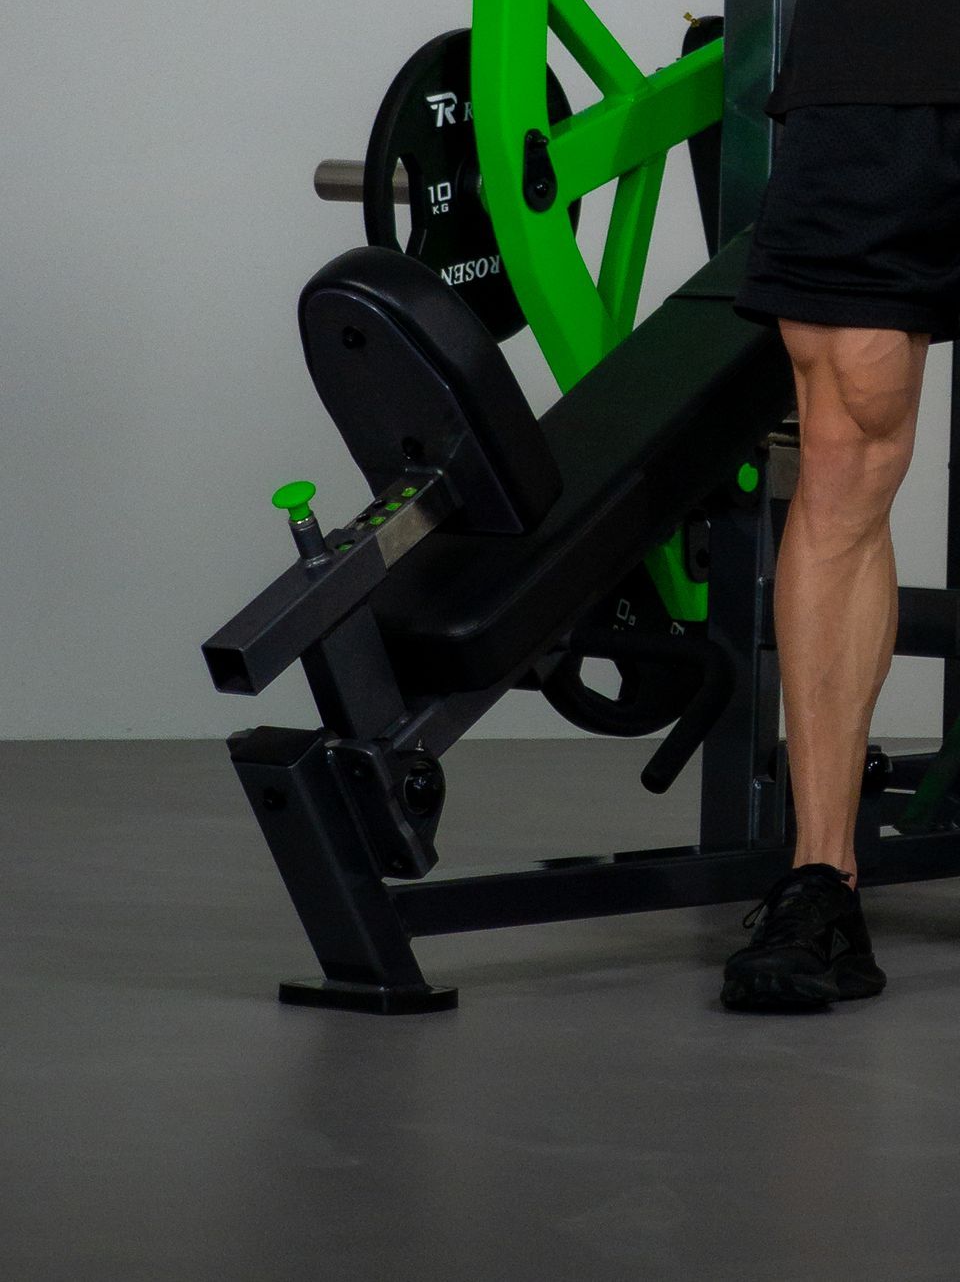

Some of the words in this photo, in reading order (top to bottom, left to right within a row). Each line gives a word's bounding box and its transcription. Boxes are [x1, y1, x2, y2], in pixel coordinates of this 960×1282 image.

[428, 181, 452, 204] 10
[432, 204, 449, 215] KG
[441, 255, 500, 286] ROSEN
